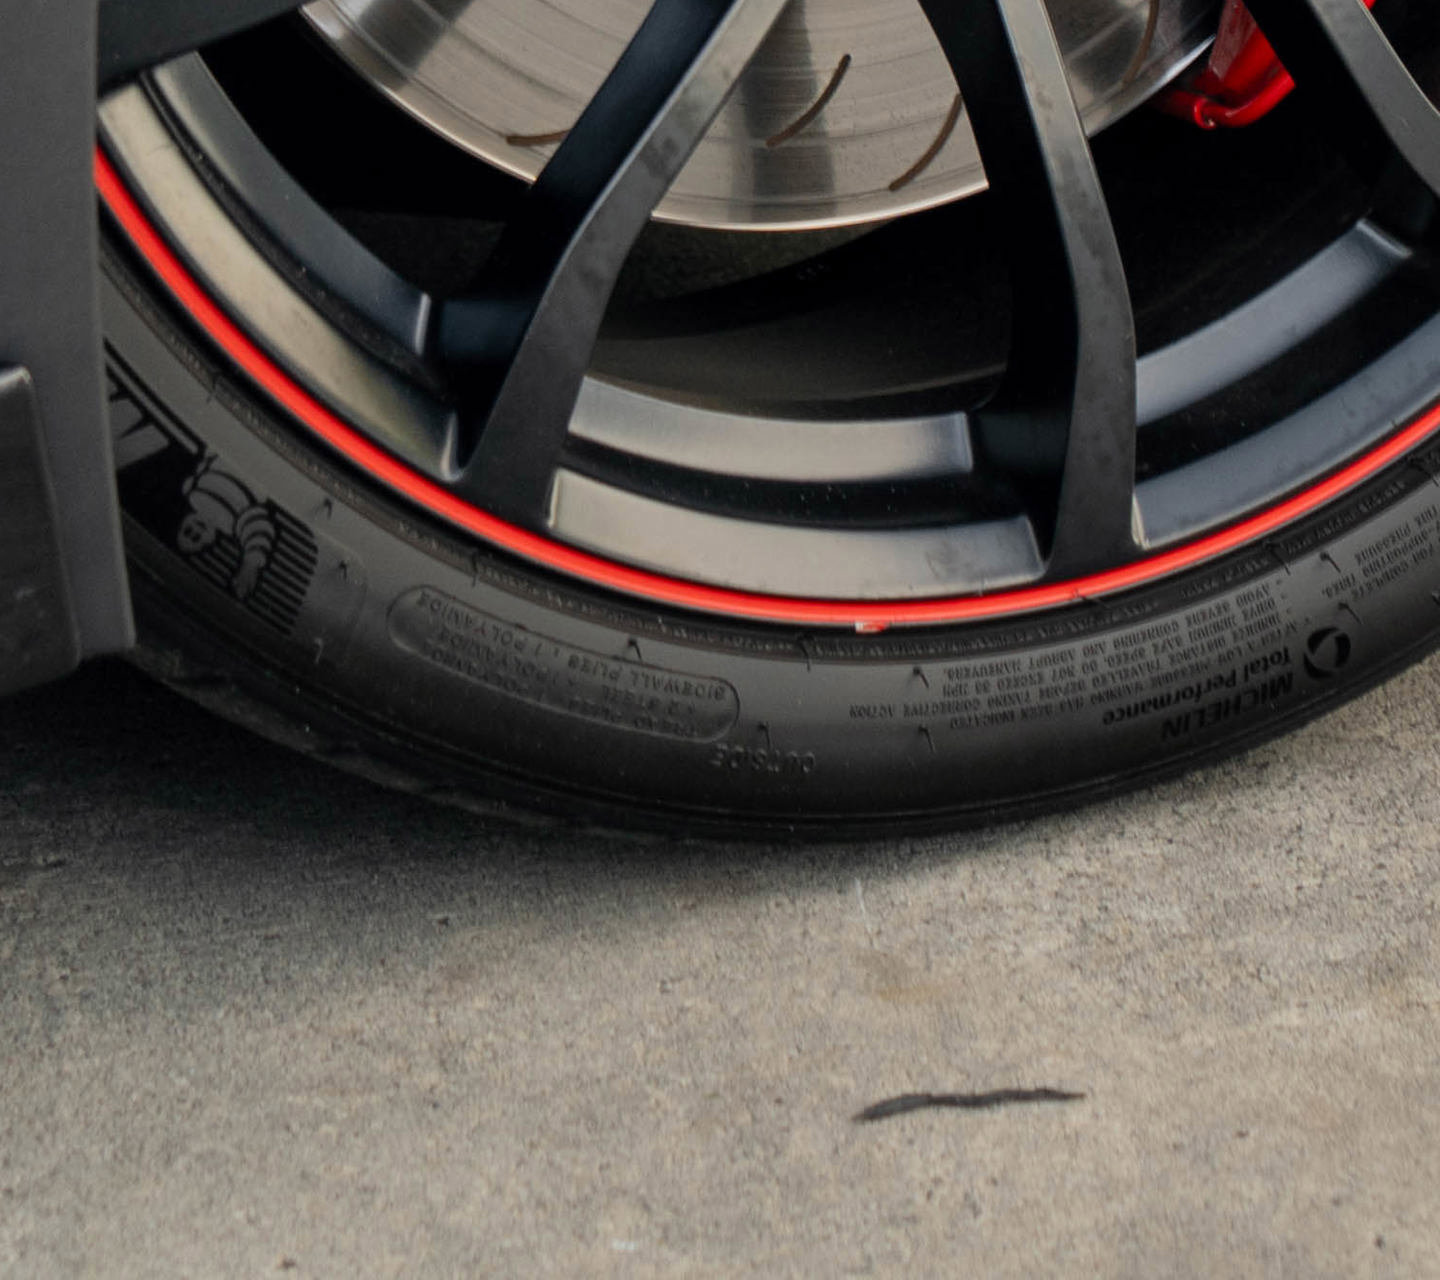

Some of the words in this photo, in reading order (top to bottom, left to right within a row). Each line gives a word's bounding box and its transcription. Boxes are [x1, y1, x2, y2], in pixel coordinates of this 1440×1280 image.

[1239, 645, 1293, 682] Total
[1100, 668, 1239, 727] Performance
[1155, 670, 1298, 741] MICHELIN
